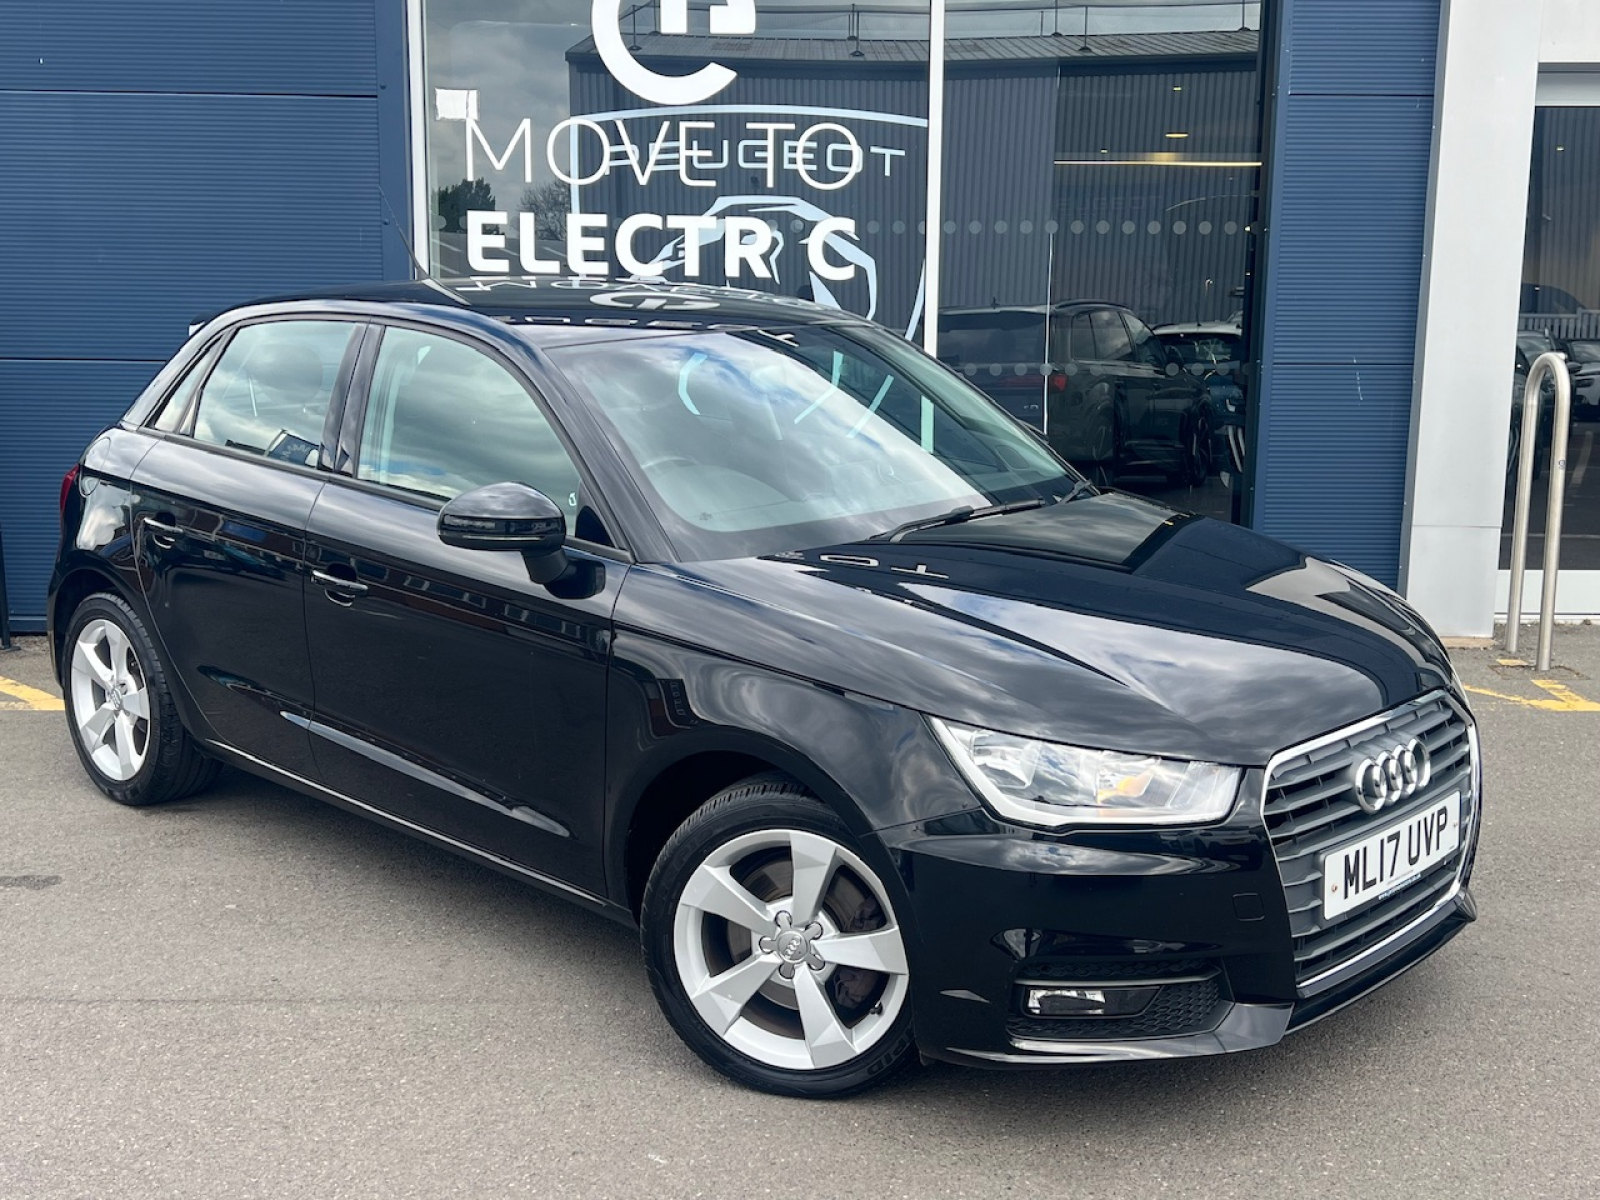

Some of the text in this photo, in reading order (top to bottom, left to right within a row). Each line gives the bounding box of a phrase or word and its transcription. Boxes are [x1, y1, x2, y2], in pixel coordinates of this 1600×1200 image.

[465, 117, 859, 190] MOVE TO
[603, 139, 906, 177] PEUGEOT
[1344, 830, 1401, 899] ML17
[1408, 806, 1447, 866] UVP
